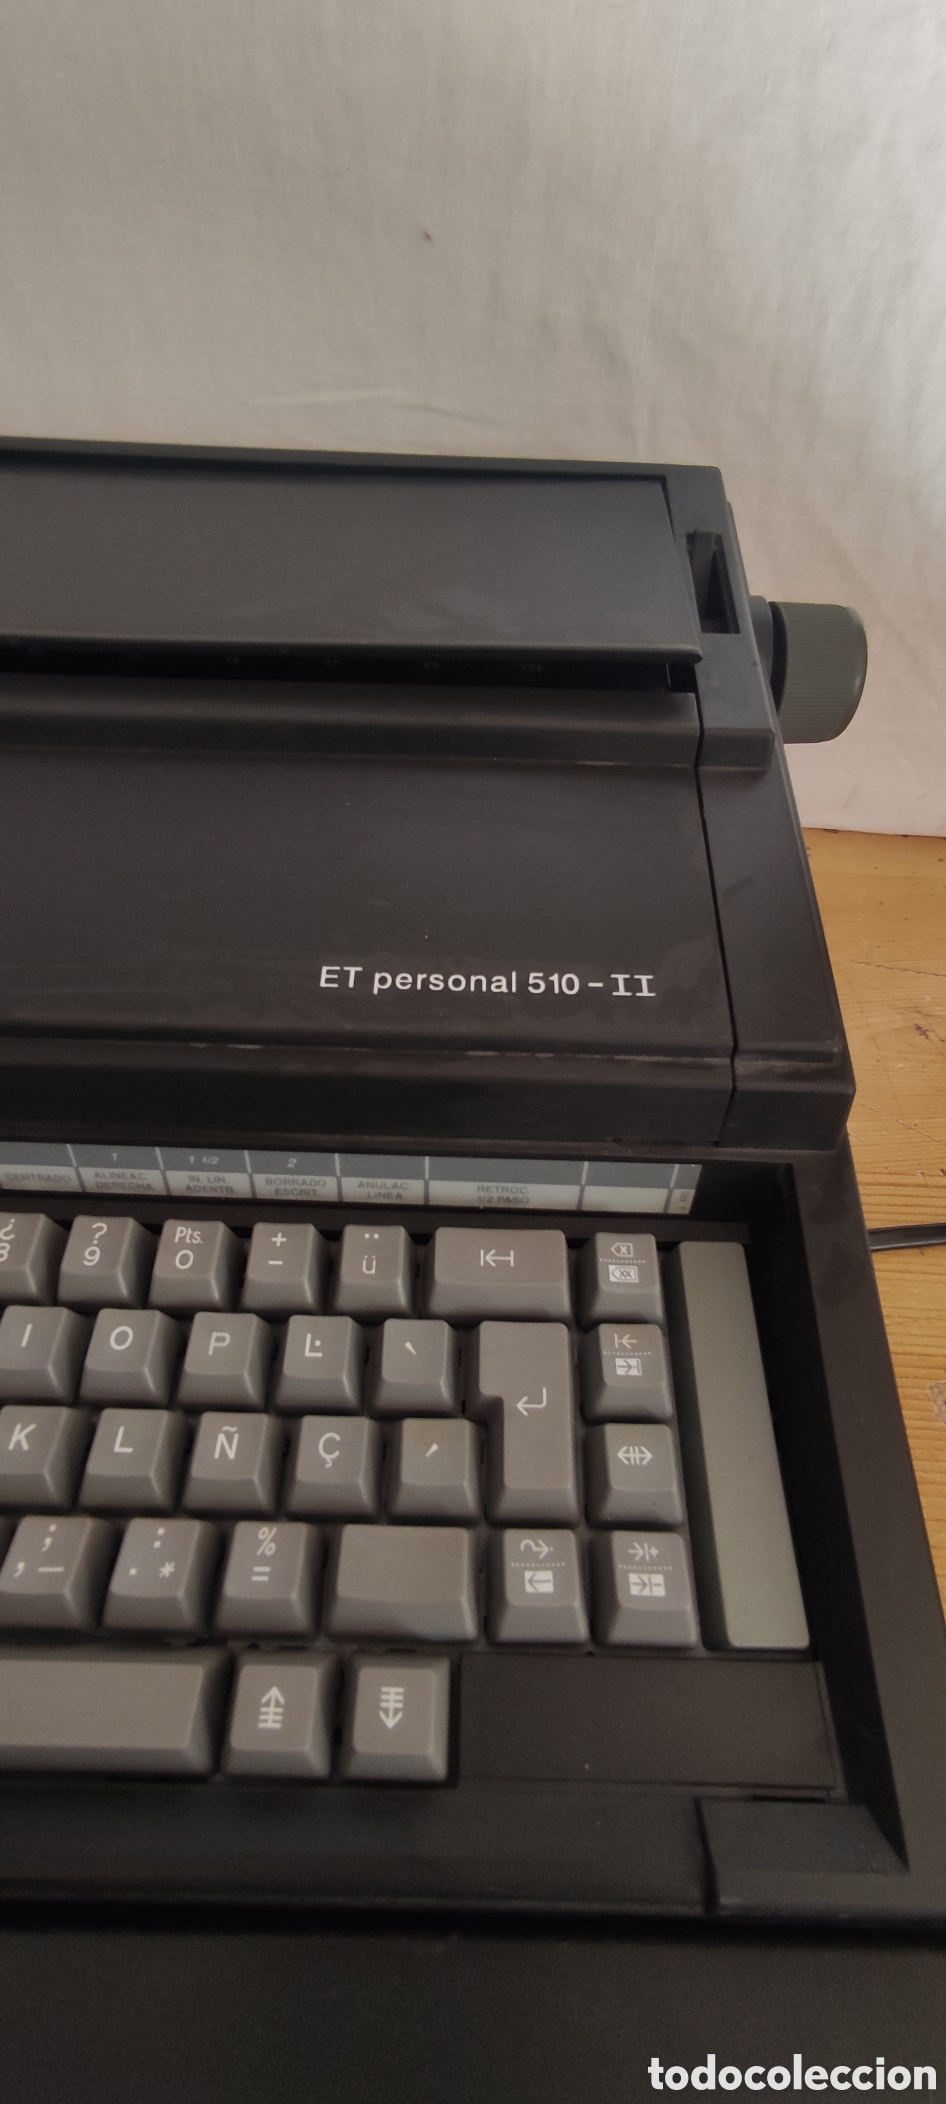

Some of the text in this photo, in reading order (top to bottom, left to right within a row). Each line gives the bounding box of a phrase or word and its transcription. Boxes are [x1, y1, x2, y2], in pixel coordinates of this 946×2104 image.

[319, 966, 363, 988] ET
[373, 970, 517, 995] personal
[112, 1152, 118, 1161] 1
[287, 1158, 297, 1168] 2
[4, 1172, 71, 1183] CENTRADO
[96, 1181, 153, 1191] DERECHA
[265, 1178, 327, 1188] BORRADO
[367, 1191, 403, 1200] LINEA
[498, 1196, 530, 1205] PASO
[91, 1222, 108, 1245] ?
[83, 1246, 101, 1266] 9
[362, 1255, 376, 1275] ü
[109, 1325, 134, 1351] O
[208, 1331, 231, 1356] P
[8, 1423, 37, 1451] K
[114, 1426, 133, 1453] L
[214, 1426, 239, 1460] Ñ
[318, 1432, 341, 1468] Ç
[256, 1526, 277, 1556] %
[251, 1566, 271, 1582] =
